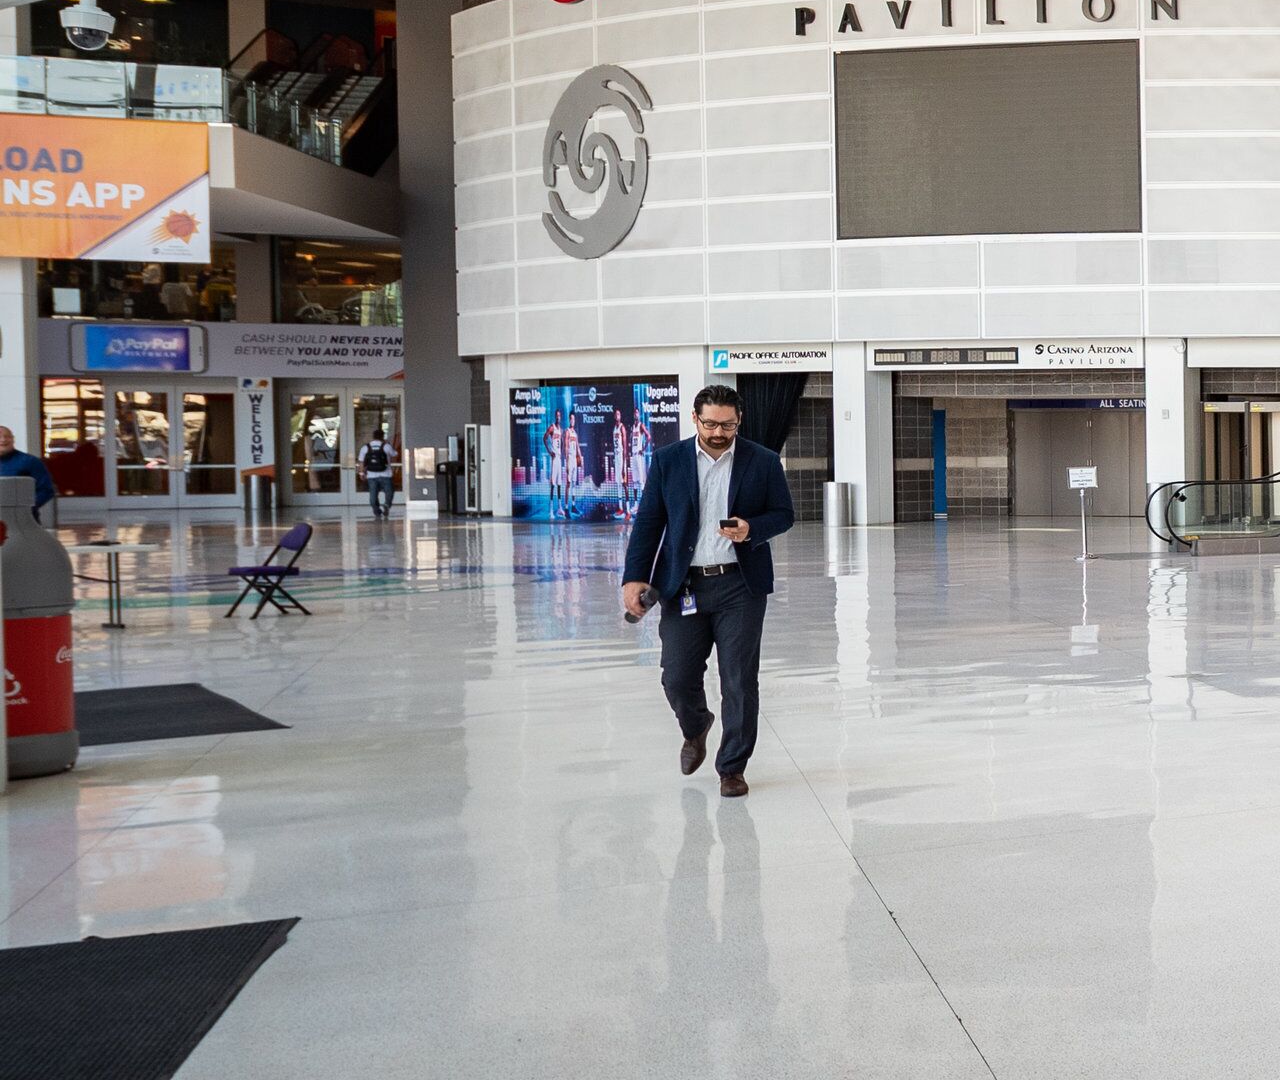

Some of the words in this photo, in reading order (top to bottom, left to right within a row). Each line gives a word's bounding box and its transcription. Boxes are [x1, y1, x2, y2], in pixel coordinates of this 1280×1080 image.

[0, 146, 84, 174] OAD
[66, 181, 145, 209] APP
[126, 338, 179, 351] PayPal
[242, 333, 275, 343] CASH
[278, 334, 328, 344] SHOULD
[330, 335, 369, 345] NEVER
[234, 345, 295, 355] BETWEEN
[297, 347, 321, 356] YOU
[323, 347, 349, 356] AND
[352, 348, 383, 357] YOUR
[730, 352, 754, 360] PACIFIC
[755, 351, 779, 359] OFFICE
[781, 350, 827, 359] AUTOMATION
[1047, 344, 1085, 355] CASINO
[1087, 344, 1134, 354] ARIZONA
[287, 359, 369, 367] PayPalSixthMan.com
[515, 389, 531, 401] Amp
[531, 389, 542, 401] Up
[646, 386, 678, 399] Upgrade
[510, 405, 526, 415] Your
[526, 404, 546, 415] Game
[573, 404, 597, 413] TALKING
[641, 403, 660, 413] Your
[1100, 399, 1114, 408] ALL
[248, 394, 263, 464] WELCOME
